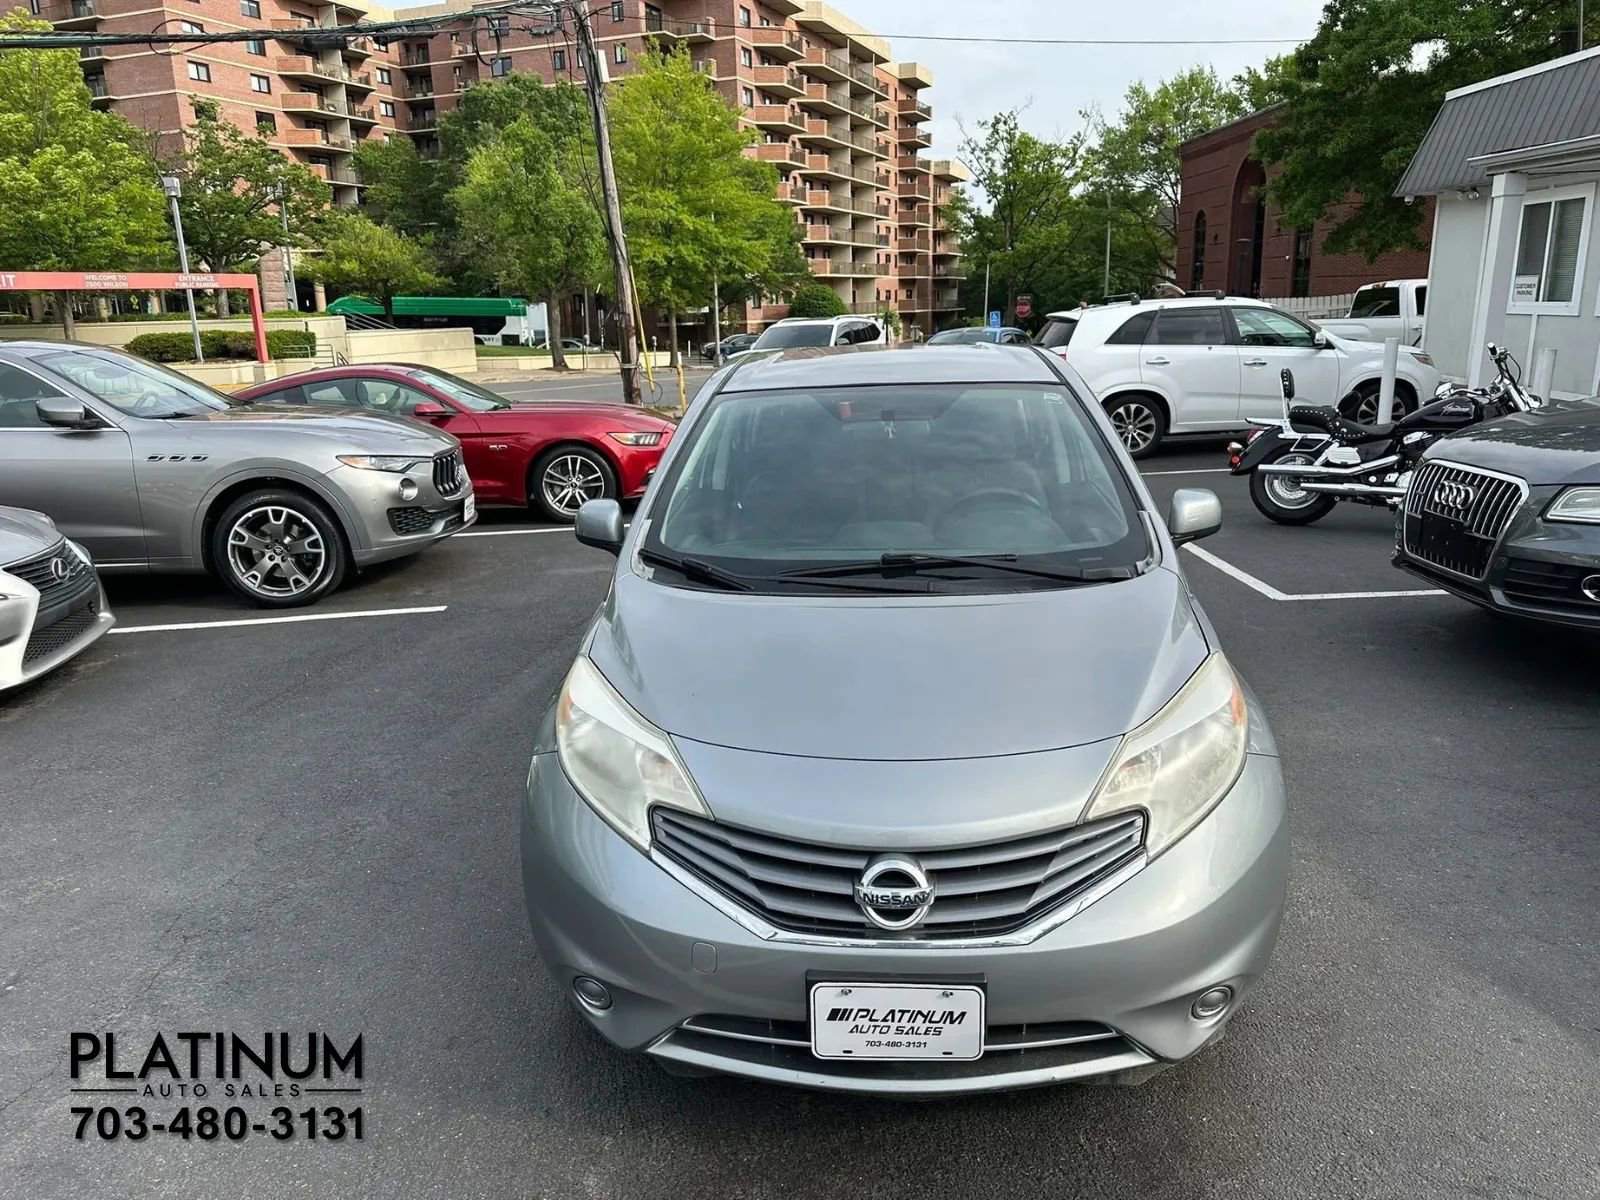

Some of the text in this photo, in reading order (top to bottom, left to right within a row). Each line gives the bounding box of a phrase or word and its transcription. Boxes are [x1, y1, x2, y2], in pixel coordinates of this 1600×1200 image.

[0, 274, 16, 288] IT
[178, 274, 215, 282] ENTRANCE
[103, 281, 128, 289] WILSON
[862, 892, 926, 906] NISSAN
[853, 1008, 967, 1025] PLATINUM
[848, 1024, 944, 1036] AUTO SALES
[865, 1040, 928, 1049] 703-480-3131
